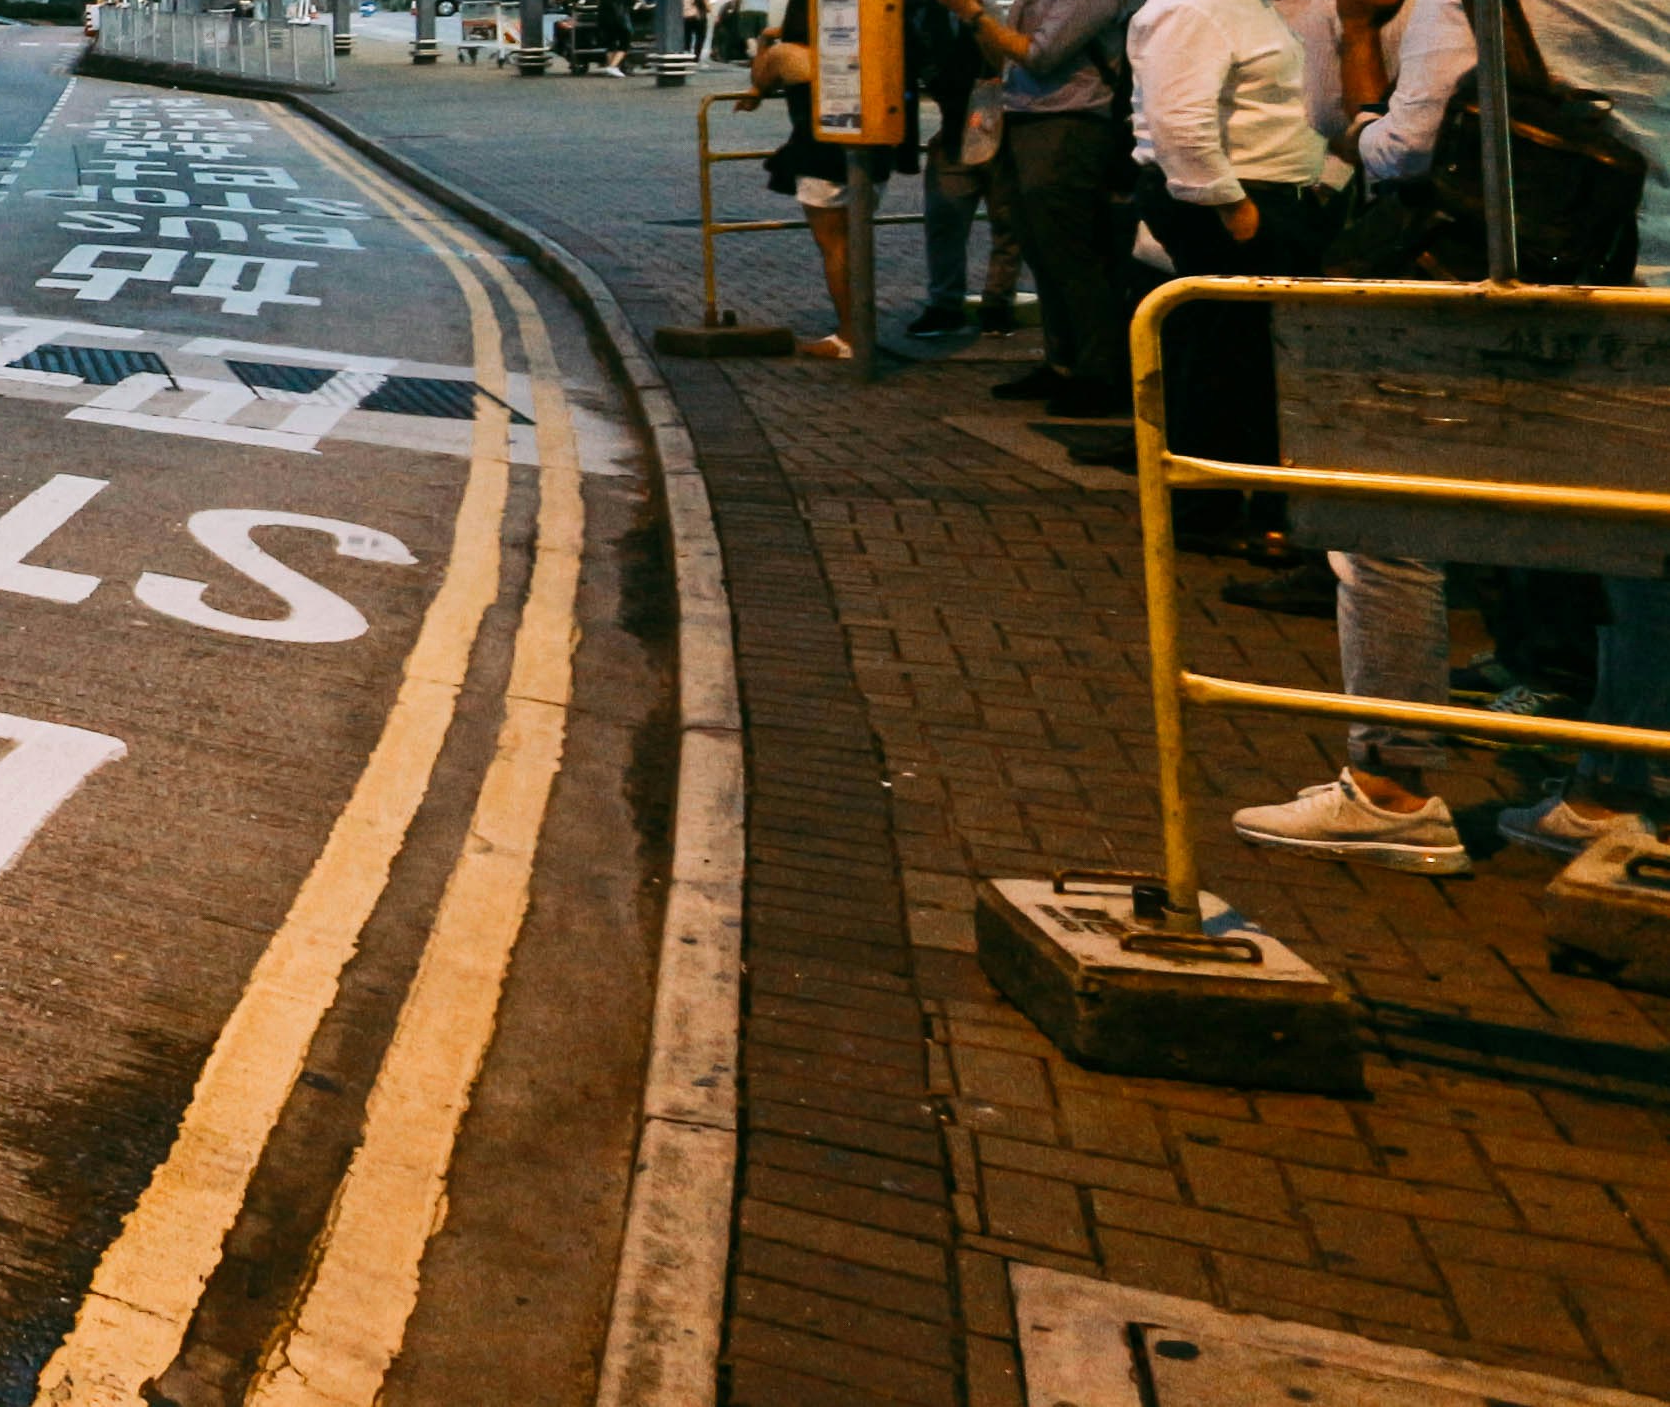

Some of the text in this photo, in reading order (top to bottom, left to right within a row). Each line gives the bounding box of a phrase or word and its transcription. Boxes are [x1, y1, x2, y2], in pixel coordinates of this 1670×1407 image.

[87, 129, 254, 143] BUS
[103, 140, 248, 161] 站
[79, 159, 301, 190] 巴士
[23, 184, 372, 220] STOP
[57, 209, 367, 251] BUS
[34, 243, 323, 317] 站
